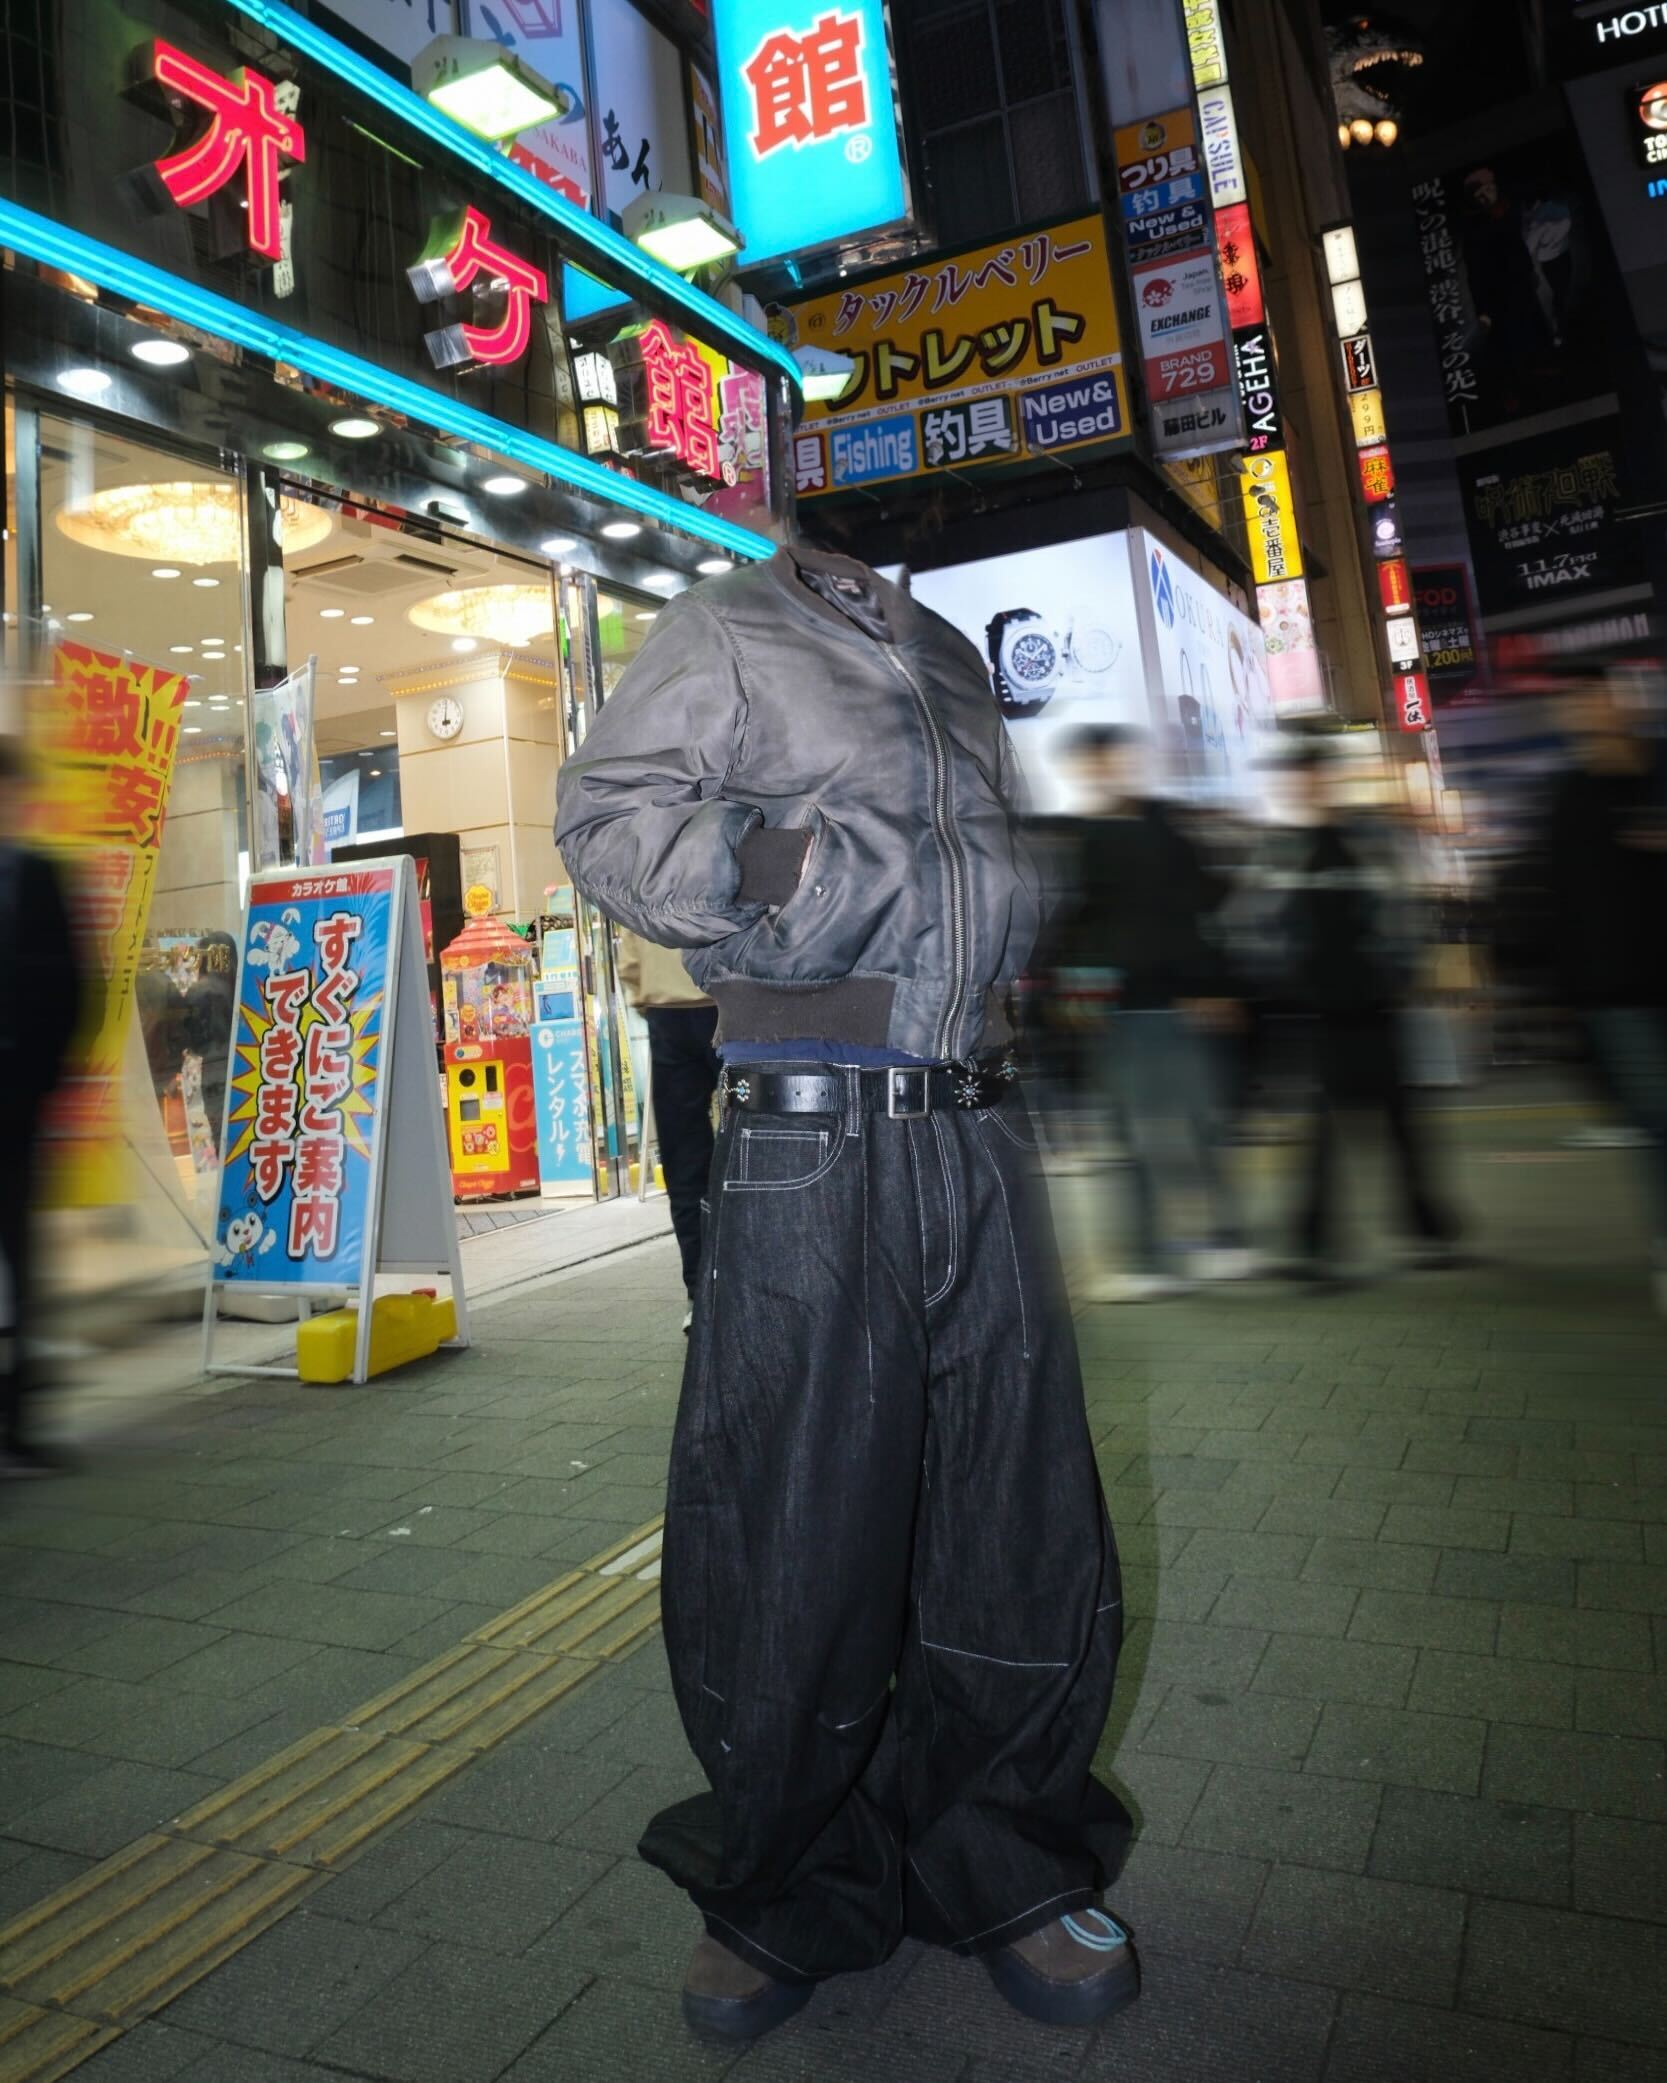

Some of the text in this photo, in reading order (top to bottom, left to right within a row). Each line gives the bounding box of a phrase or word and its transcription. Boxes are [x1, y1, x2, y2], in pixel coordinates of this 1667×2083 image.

[739, 7, 868, 164] 館
[1121, 146, 1197, 190] つり具
[1129, 205, 1196, 234] New &
[1149, 214, 1204, 240] Used
[832, 234, 1092, 337] タックルベリー
[1150, 304, 1211, 333] EXCHANGE
[1076, 356, 1113, 372] OUTLET
[1160, 350, 1213, 372] BRAND
[1353, 338, 1371, 378] ダーツ
[1161, 362, 1216, 393] 729
[1240, 334, 1277, 432] AGEHA
[924, 397, 1013, 462] 釣具
[1035, 405, 1115, 446] Used
[1162, 406, 1228, 437] 藤田ビル
[832, 425, 912, 482] Fishing
[1250, 435, 1269, 450] 2F
[1362, 456, 1388, 494] 麻雀
[1526, 563, 1591, 590] IMAX
[1400, 661, 1414, 671] 3F
[250, 970, 310, 1203] できます
[287, 913, 361, 1259] すぐにご案内
